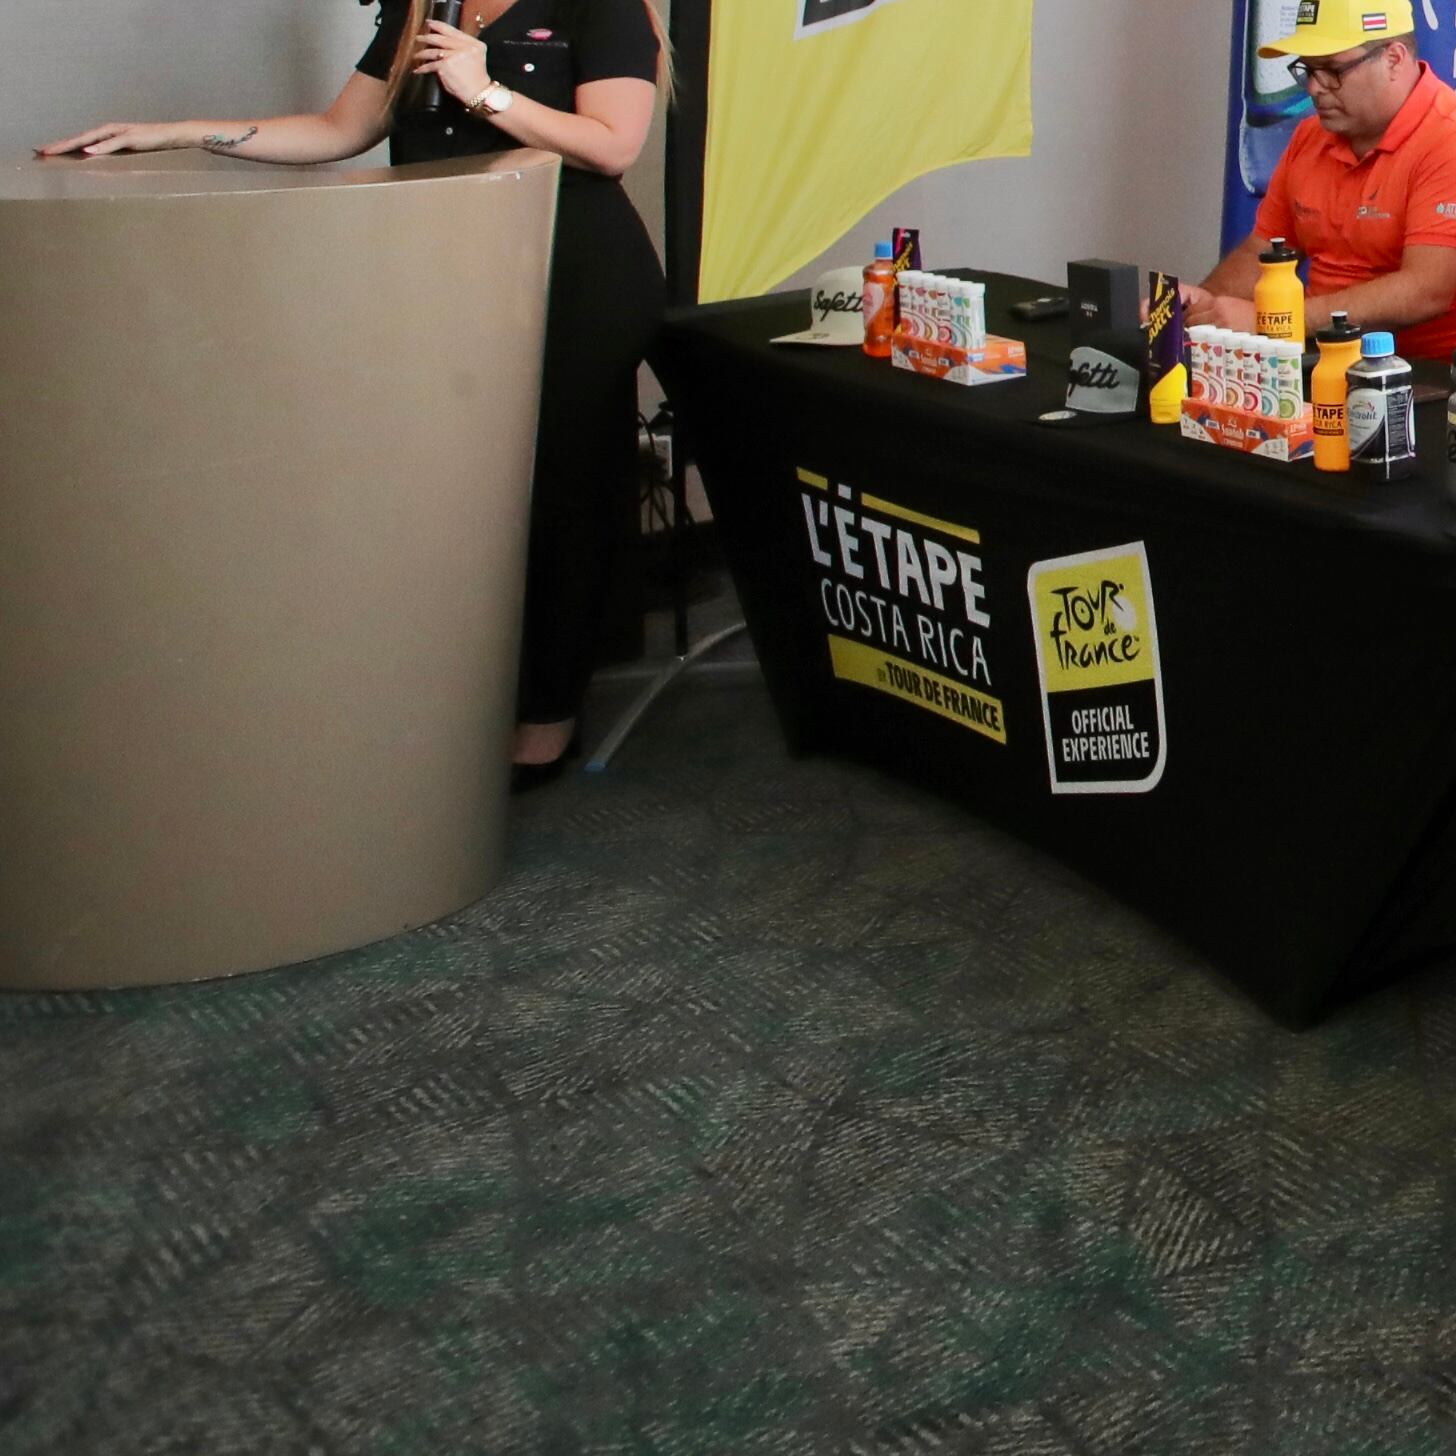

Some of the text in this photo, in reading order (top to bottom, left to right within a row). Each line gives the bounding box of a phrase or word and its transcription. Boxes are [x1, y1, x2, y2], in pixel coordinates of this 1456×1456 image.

[814, 289, 864, 322] Safett
[1067, 361, 1120, 397] fetti
[1050, 579, 1125, 630] TOUR
[821, 578, 992, 686] COSTA RICA
[886, 660, 921, 698] TOUR
[922, 676, 943, 706] DE
[943, 683, 1001, 732] FRANCE
[1071, 704, 1134, 733] OFFICIAL
[1062, 731, 1150, 762] EXPERIENCE
